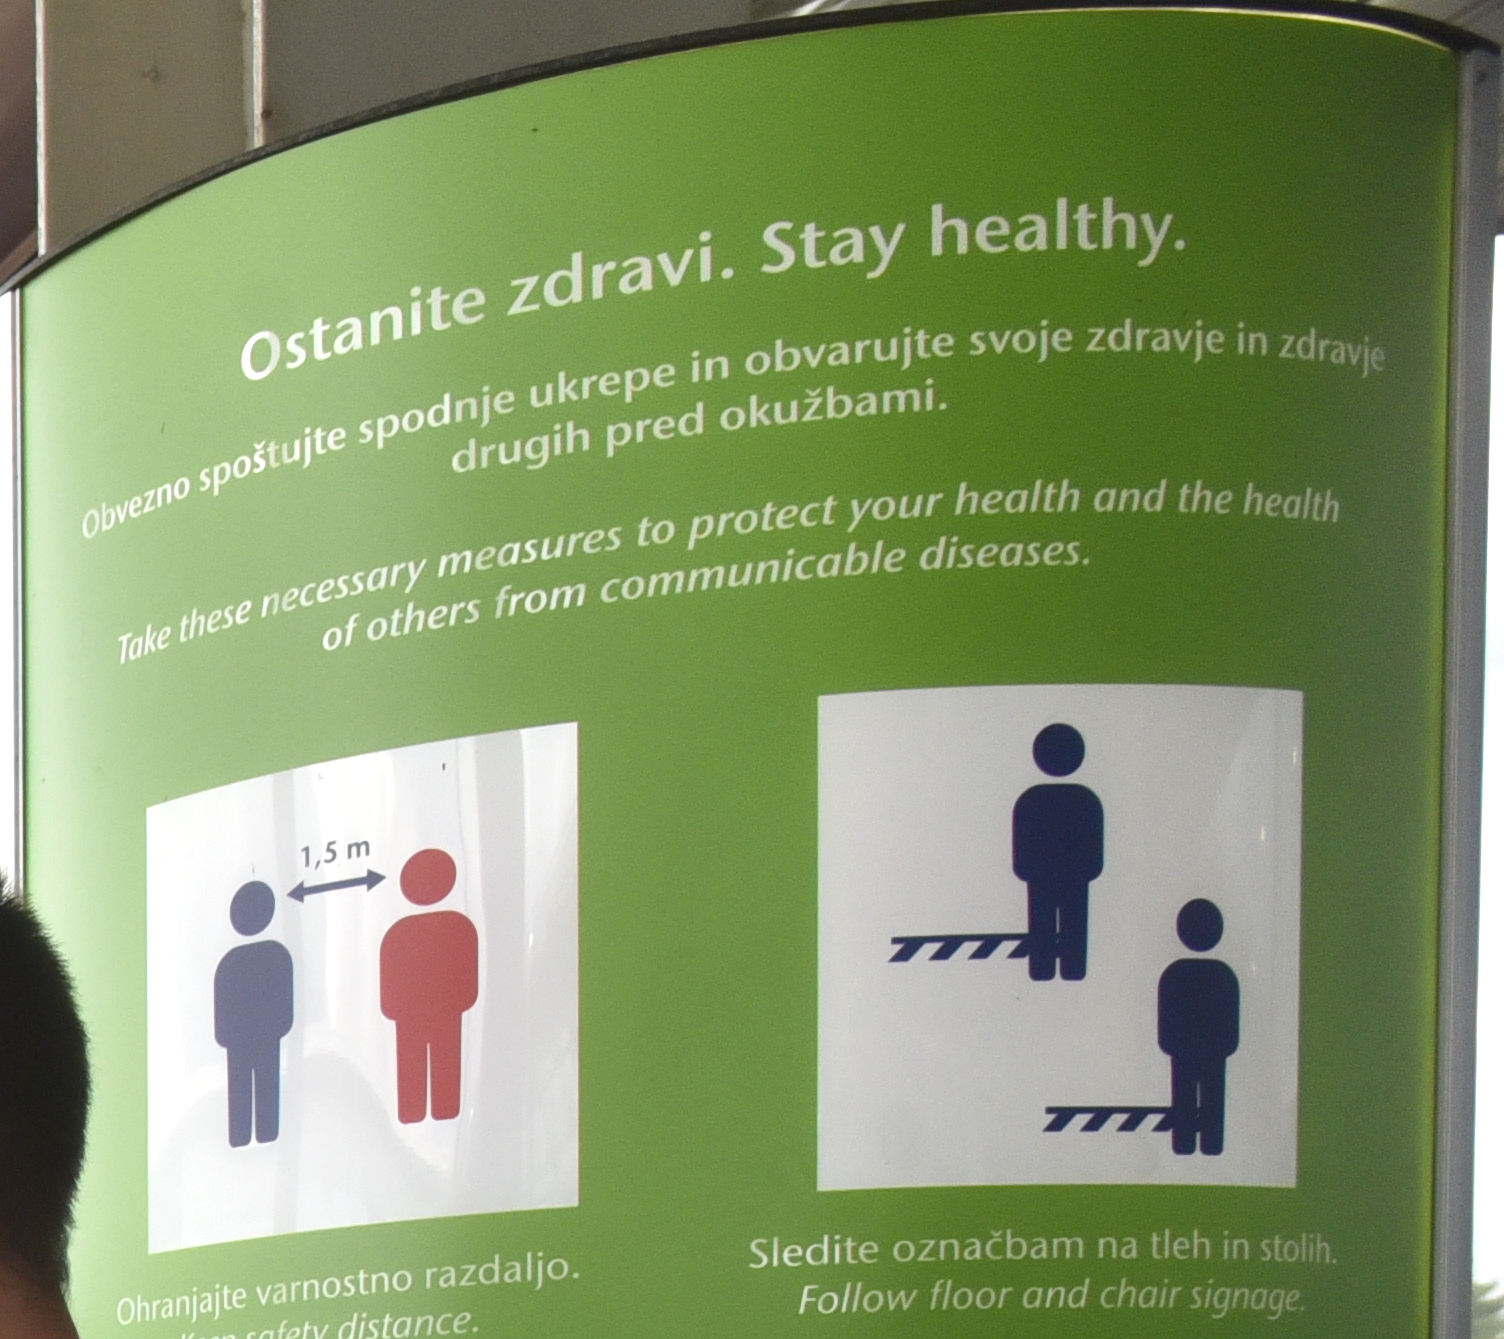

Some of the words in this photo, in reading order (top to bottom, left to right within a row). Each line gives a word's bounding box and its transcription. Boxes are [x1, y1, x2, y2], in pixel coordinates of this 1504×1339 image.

[240, 285, 486, 381] Ostanite
[507, 230, 735, 316] zdravi.
[761, 220, 907, 280] Stay
[931, 196, 1186, 267] healthy.
[82, 476, 191, 539] Obvezno
[199, 426, 347, 496] spoštujte
[359, 385, 516, 450] spodnje
[529, 363, 676, 409] ukrepe
[691, 350, 730, 383] in
[744, 326, 955, 376] obvarujte
[969, 319, 1074, 363] svoje
[1085, 317, 1225, 363] zdravje
[1237, 321, 1269, 356] in
[1278, 326, 1386, 378] zdravje
[451, 420, 591, 473] drugih
[606, 401, 705, 458] pred
[719, 377, 948, 431] okužbami.
[118, 623, 172, 664] Take
[179, 599, 253, 643] these
[260, 558, 428, 618] necessary
[437, 526, 622, 578] measures
[637, 516, 676, 547] to
[687, 495, 838, 551] protect
[847, 492, 944, 533] your
[954, 478, 1081, 516] health
[1093, 478, 1168, 513] and
[1178, 479, 1234, 515] the
[1242, 481, 1340, 523] health
[322, 613, 360, 651] of
[366, 599, 480, 641] others
[495, 583, 587, 619] from
[600, 539, 907, 603] communicable
[919, 535, 1090, 571] diseases.
[299, 838, 338, 870] 1,5
[346, 837, 371, 860] m
[116, 1283, 248, 1326] Ohranjajte
[255, 1269, 413, 1306] varnostno
[425, 1251, 580, 1291] razdaljo.
[749, 1234, 879, 1269] Sledite
[892, 1228, 1085, 1263] označbam
[1097, 1236, 1139, 1260] na
[1150, 1228, 1211, 1260] tleh
[1222, 1229, 1251, 1261] in
[1259, 1232, 1338, 1265] stolih.
[798, 1281, 918, 1315] Follow
[929, 1278, 1014, 1311] floor
[1021, 1277, 1091, 1310] and
[1099, 1277, 1183, 1309] chair
[1189, 1278, 1305, 1321] signage.
